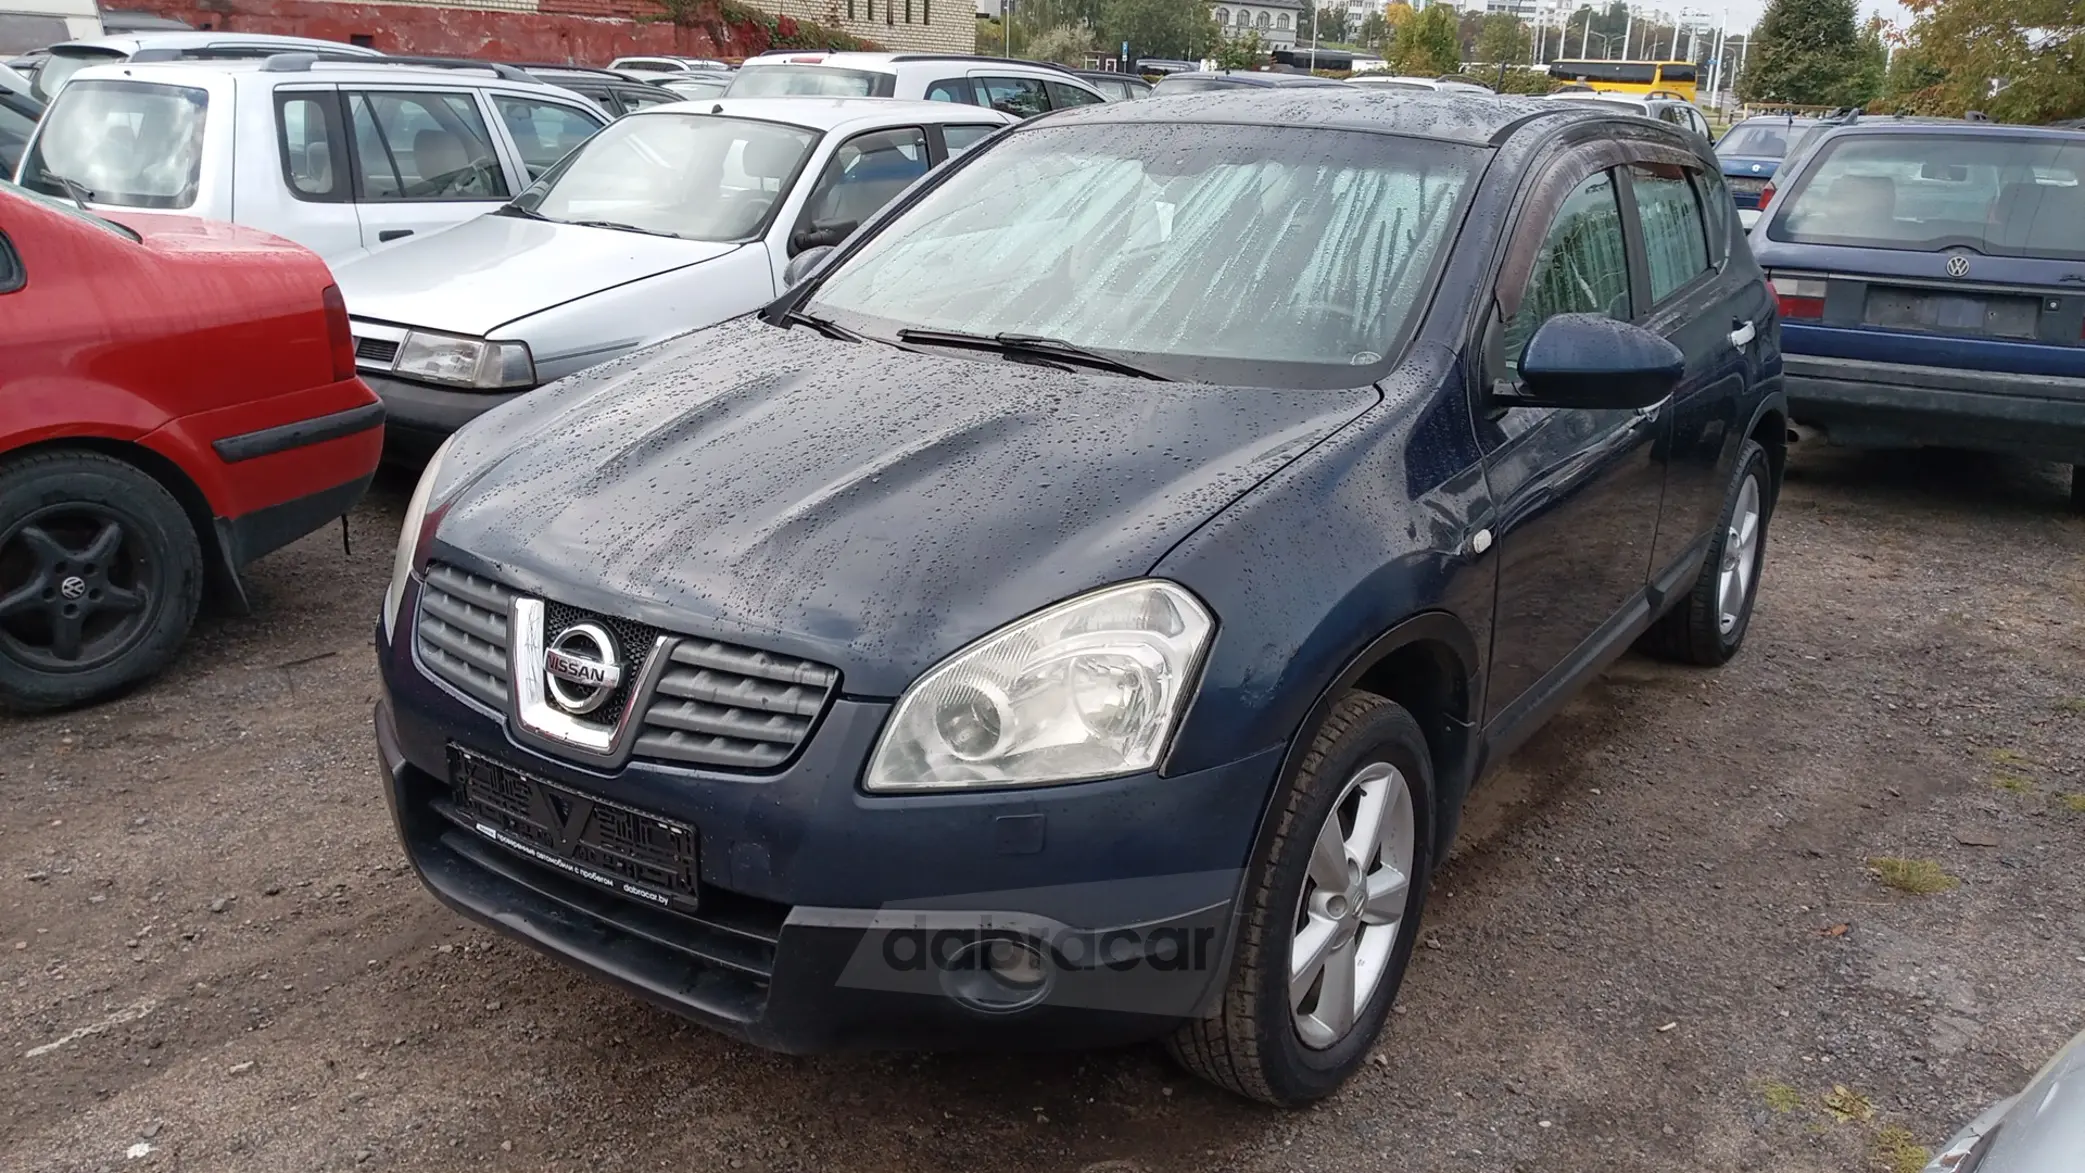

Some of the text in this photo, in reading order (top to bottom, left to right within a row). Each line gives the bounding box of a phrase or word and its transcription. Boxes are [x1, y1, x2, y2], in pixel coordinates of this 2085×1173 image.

[548, 653, 605, 682] NISSAN
[536, 851, 574, 872] автомобили
[580, 869, 614, 887] пробегом
